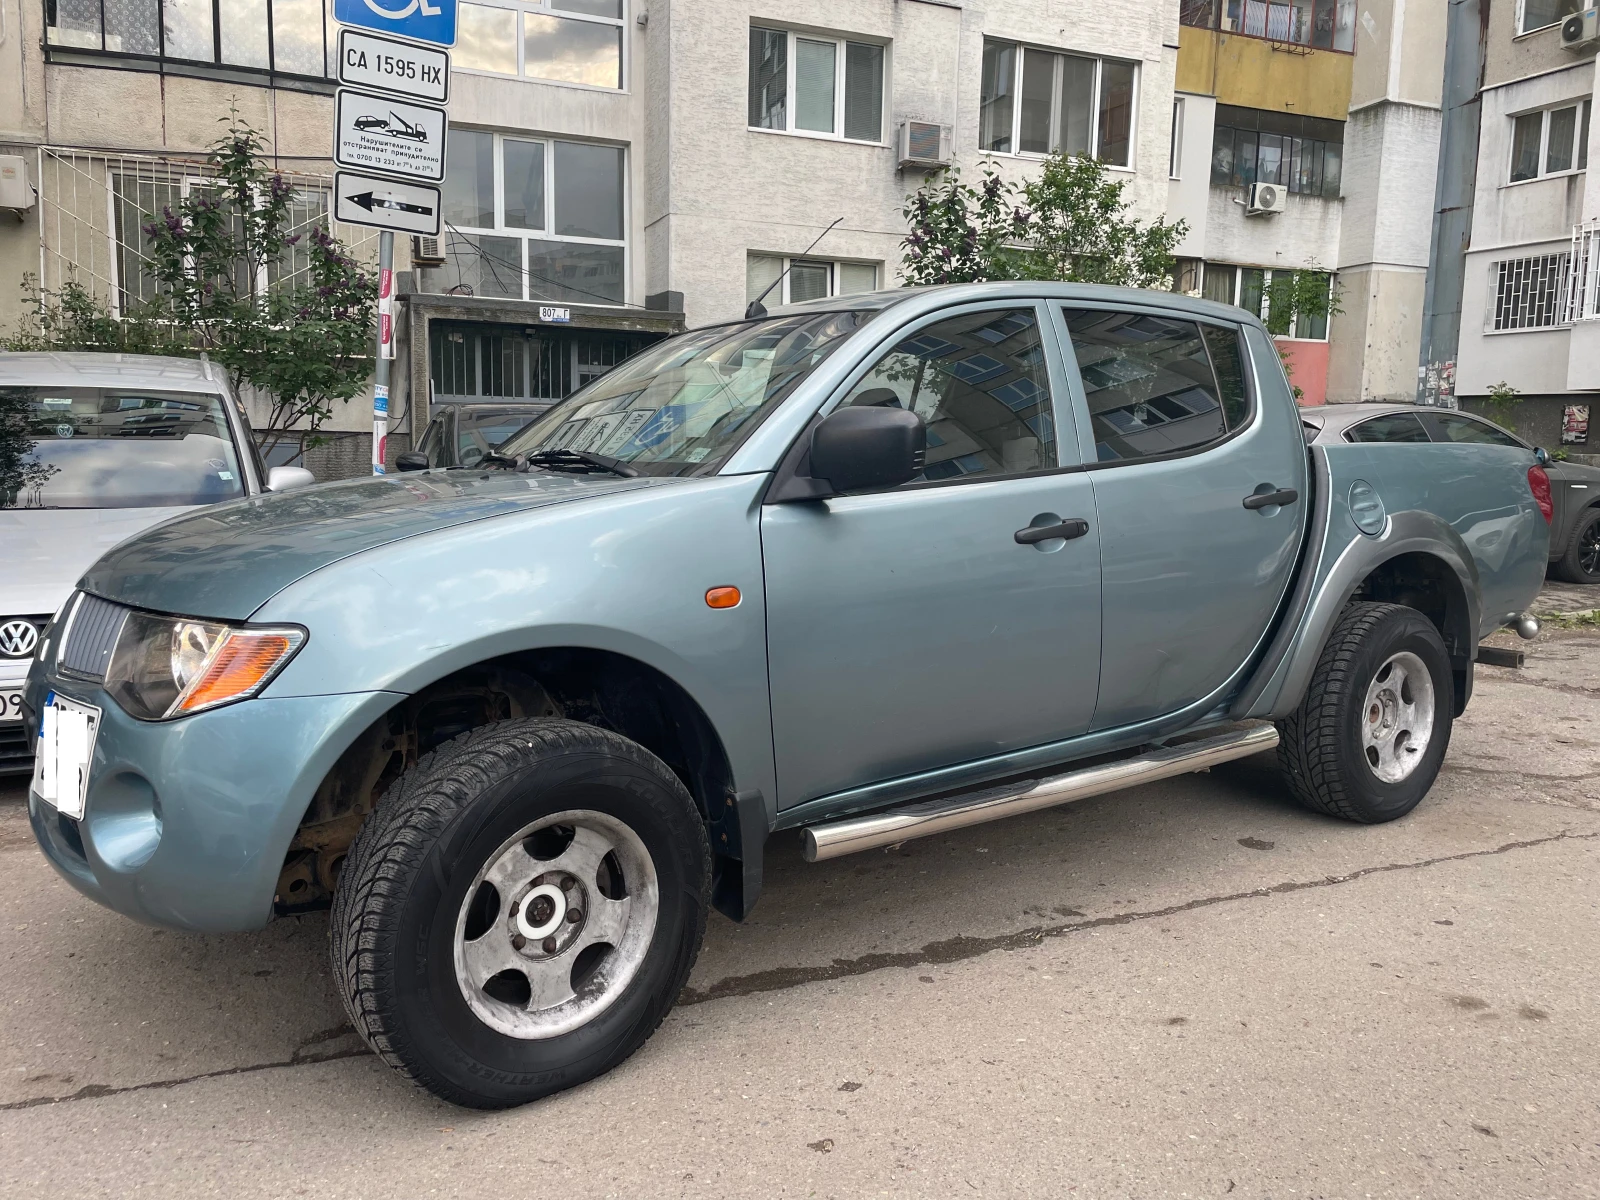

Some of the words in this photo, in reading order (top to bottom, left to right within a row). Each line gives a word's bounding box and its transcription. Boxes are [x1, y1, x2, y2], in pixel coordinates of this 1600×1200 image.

[376, 54, 416, 79] 1595
[360, 135, 411, 151] Нарушителите
[343, 141, 388, 154] отстраняват
[390, 149, 439, 163] принудително
[356, 153, 373, 162] 0700
[383, 158, 395, 166] 233
[542, 307, 556, 318] 807
